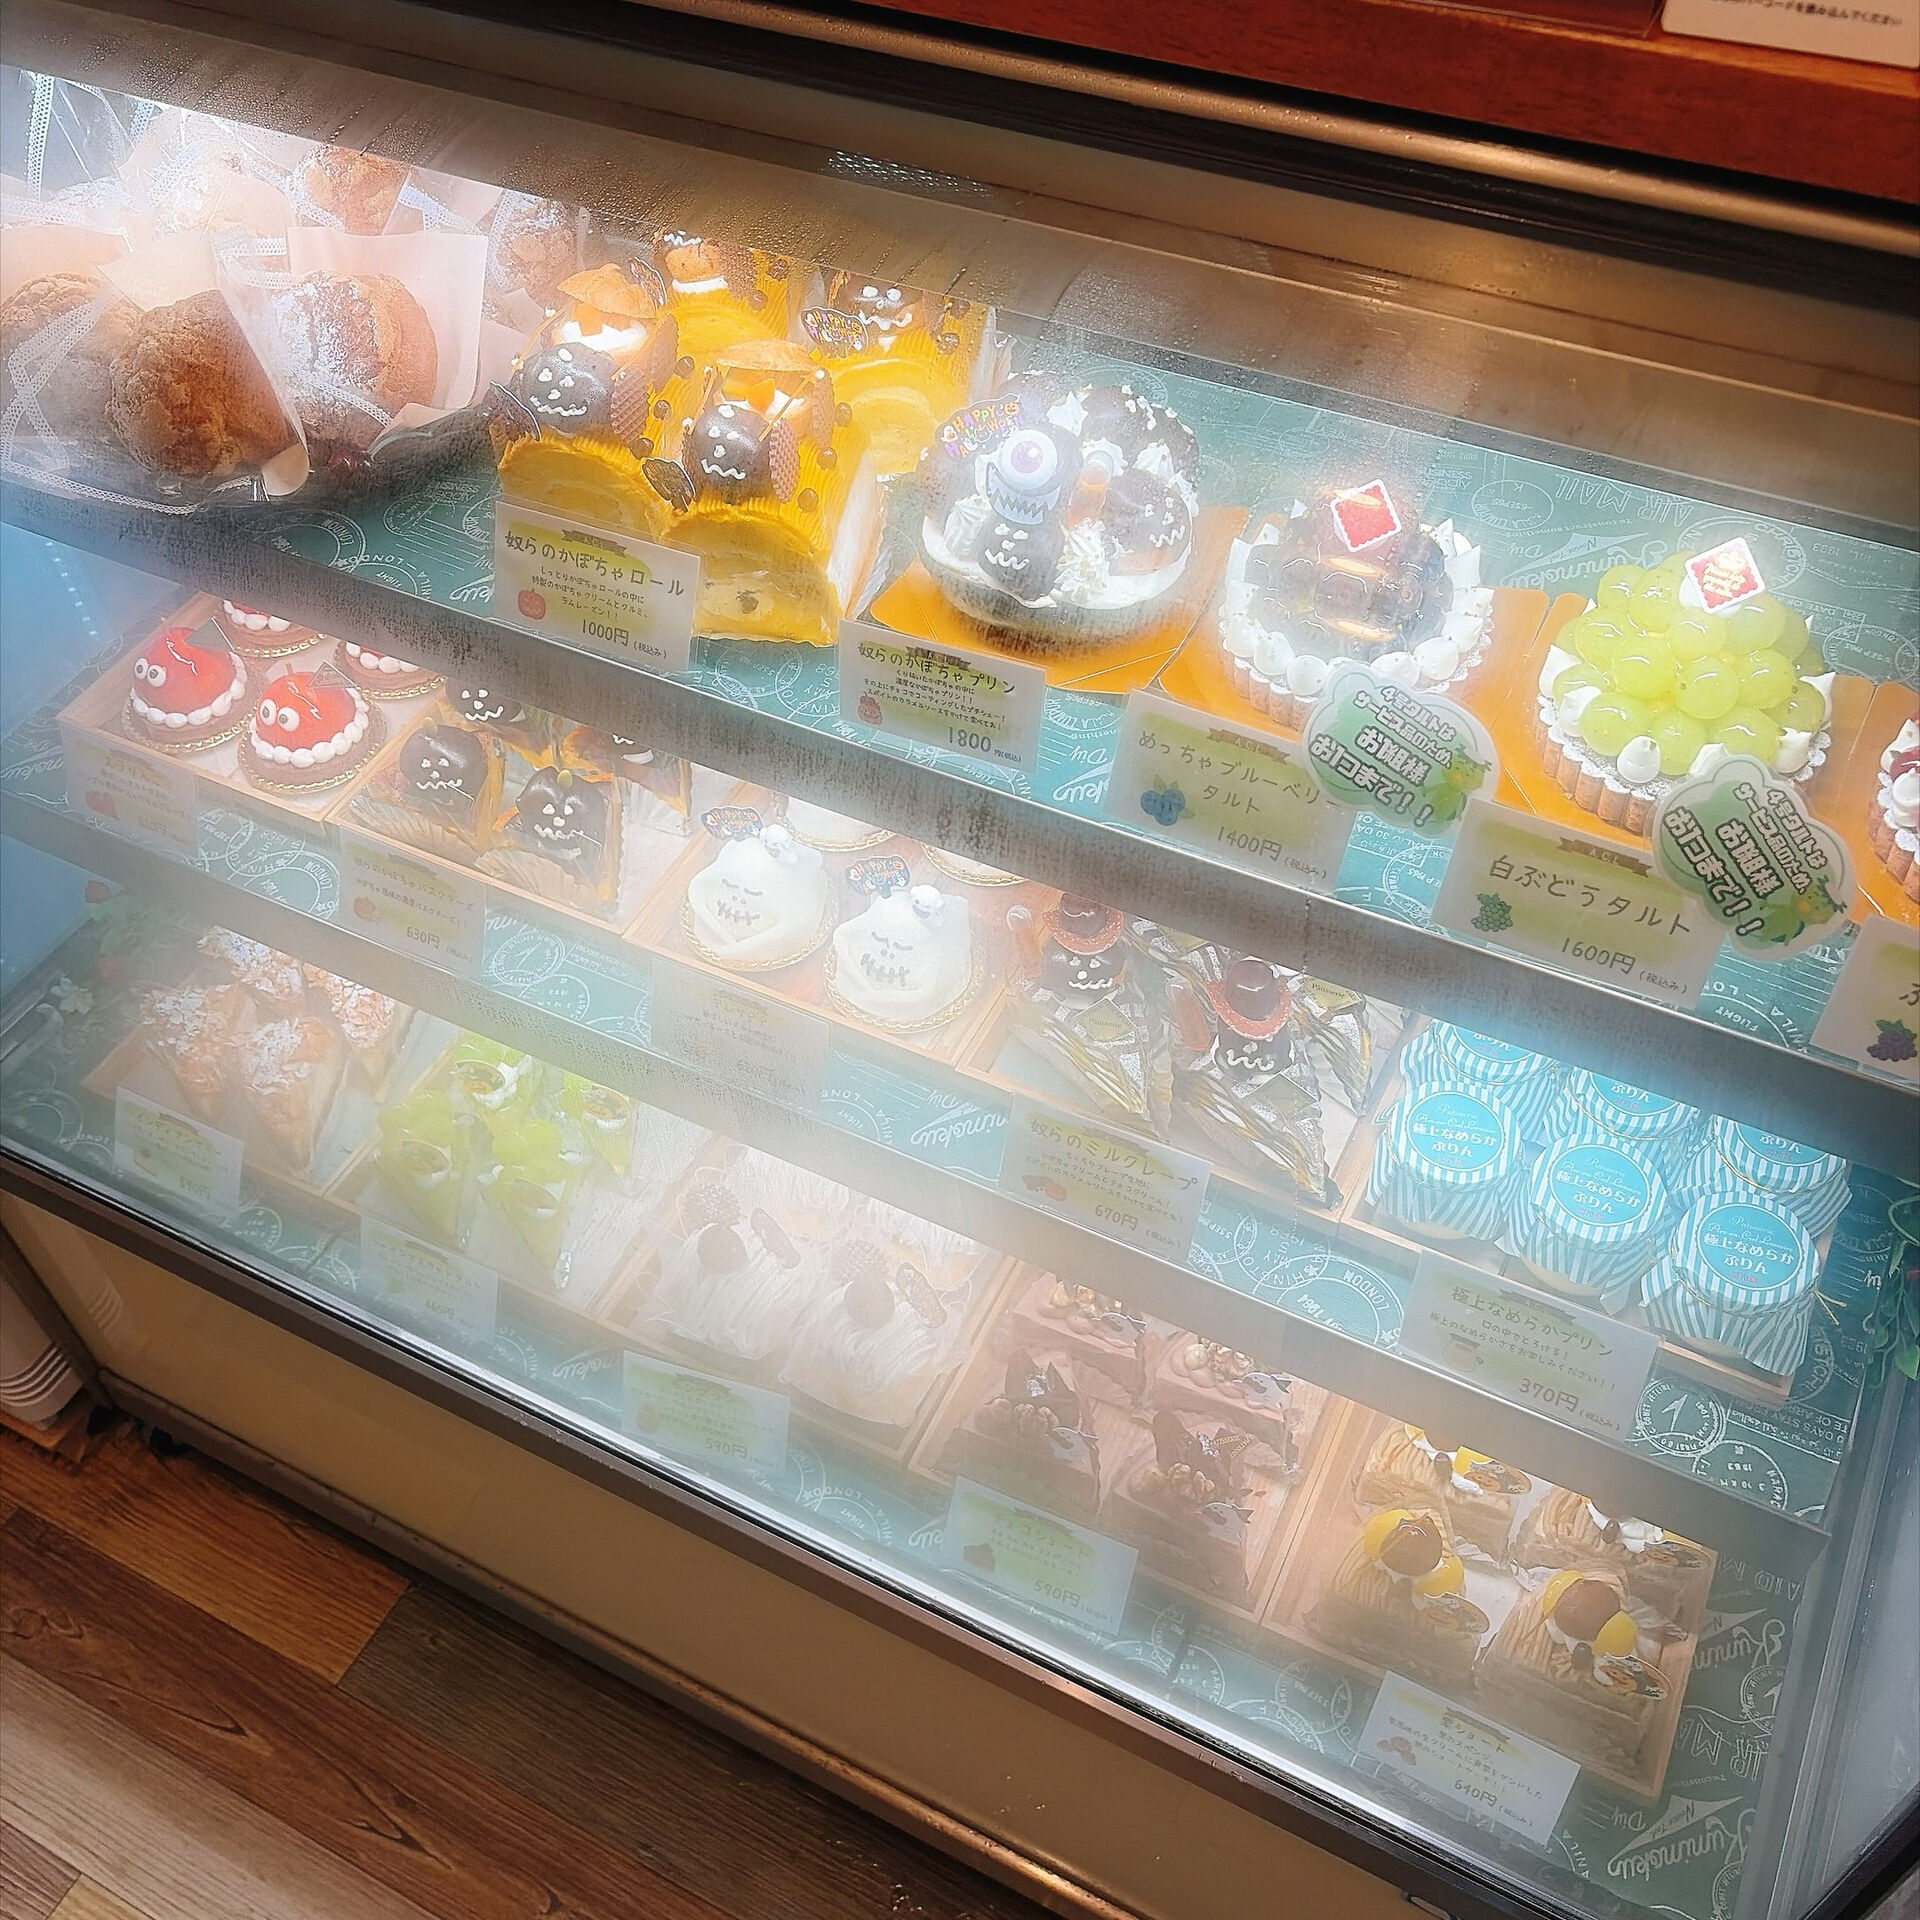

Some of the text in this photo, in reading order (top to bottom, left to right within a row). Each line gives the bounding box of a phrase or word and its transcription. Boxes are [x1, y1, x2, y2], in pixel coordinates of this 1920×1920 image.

[1555, 473, 1634, 514] MAIL
[504, 530, 685, 598] 奴らのかぼちゃロール
[540, 564, 646, 605] しっとりかぼちゃロールの中に
[581, 618, 630, 647] 1000円
[856, 642, 1016, 694] 奴らのかぼちゃプリン
[1352, 690, 1453, 769] サービス品のため、
[1380, 684, 1458, 743] 4号タルトは
[948, 726, 993, 753] 1800
[1137, 730, 1343, 811] めっちゃブルーベリー
[1202, 784, 1261, 815] タルト
[1217, 825, 1282, 862] 1400円
[1731, 781, 1813, 896] サービス品のため、
[1766, 788, 1829, 870] 4号タルトは
[1488, 853, 1691, 936] 白ぶどうタルト
[406, 925, 441, 950] 630円
[1560, 935, 1637, 975] 1600円
[1714, 1005, 1759, 1032] FLIGHT
[837, 1110, 864, 1130] FLIGHT
[1412, 1121, 1497, 1147] 極上なめらか
[1029, 1118, 1198, 1190] 奴らのミルクレープ
[1555, 1169, 1641, 1208] 極上なめらか
[1094, 1203, 1139, 1231] 670円
[1702, 1232, 1795, 1266] 極上なめらか
[1343, 1268, 1391, 1312] LONDON
[1450, 1285, 1614, 1357] 極上なめらかプリン
[1481, 1318, 1569, 1361] 口の中でとろける！
[1517, 1376, 1580, 1414] 370円
[705, 1437, 748, 1460] 590円
[1802, 1421, 1834, 1440] DAYS
[1033, 1579, 1081, 1608] 590円
[1453, 1779, 1499, 1808] 640円
